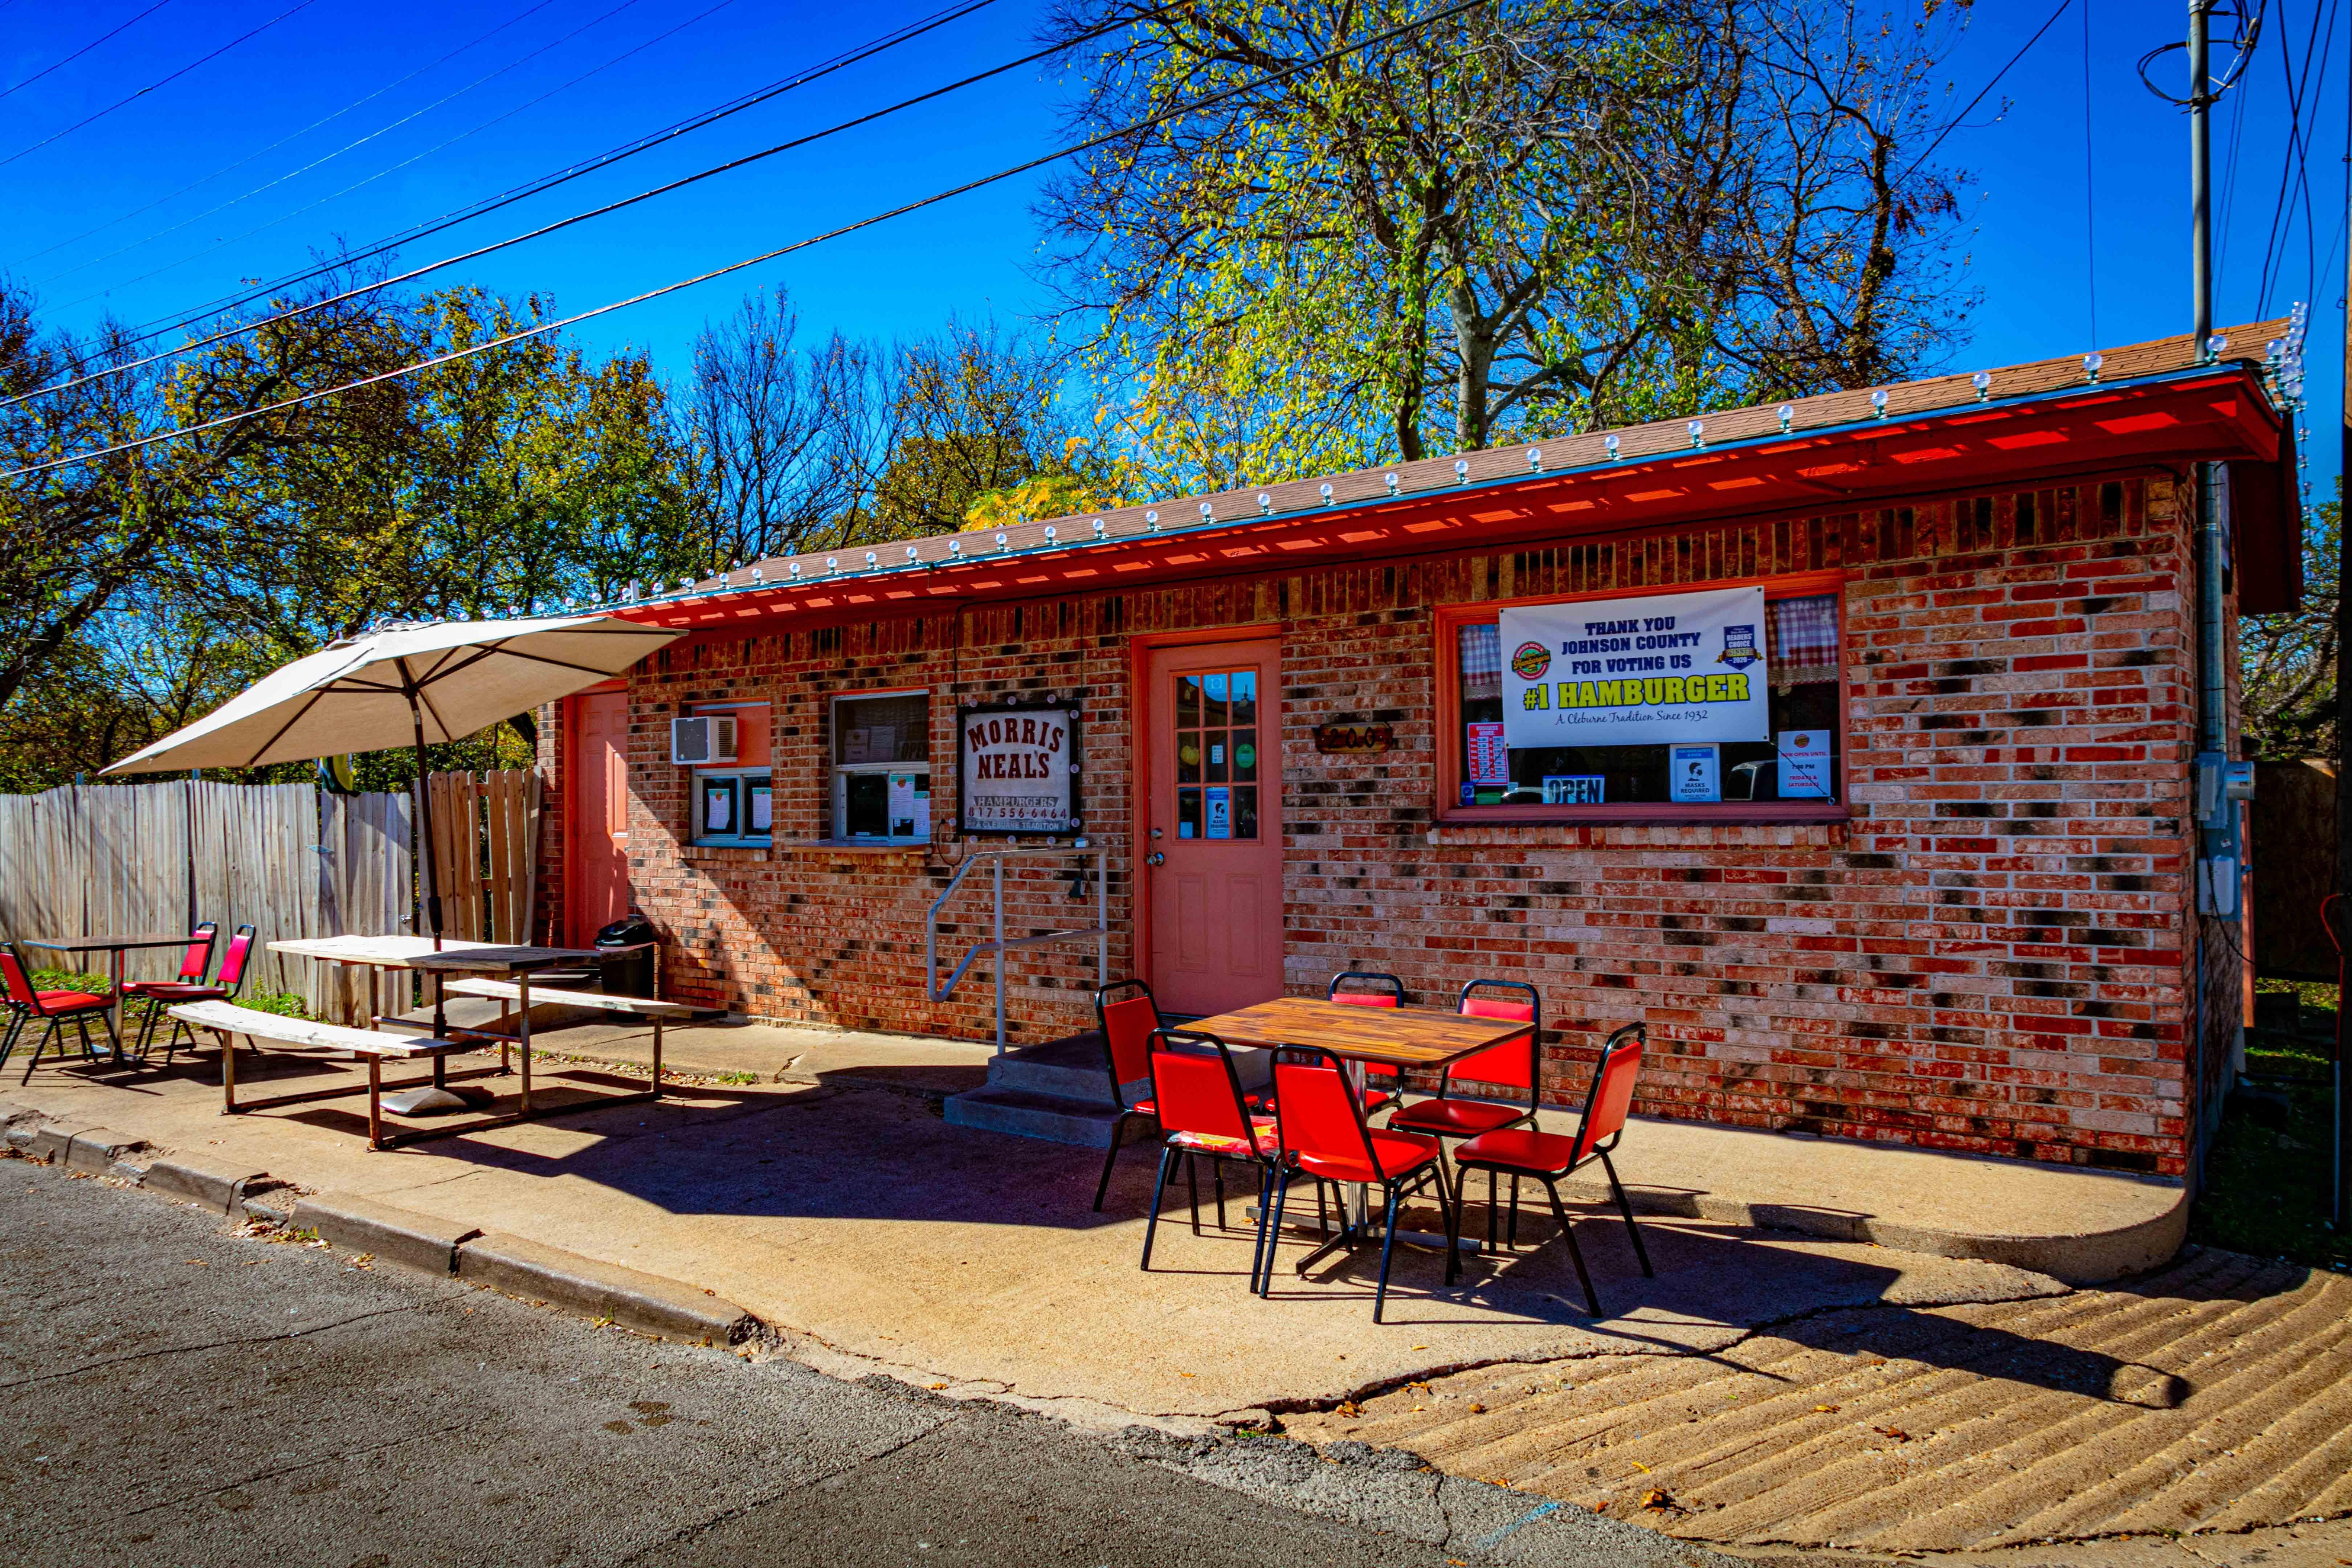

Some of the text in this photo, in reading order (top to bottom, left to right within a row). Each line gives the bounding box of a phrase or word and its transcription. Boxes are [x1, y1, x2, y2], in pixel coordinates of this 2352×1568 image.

[1585, 616, 1675, 636] THANK YOU
[1562, 632, 1701, 655] JOHNSON COUNTY
[1572, 654, 1691, 674] FOR VOTING US
[1523, 673, 1750, 711] #1 HAMBURGER
[1555, 710, 1708, 726] A Cleburne Tradition Since 1932
[967, 718, 1064, 752] MORRIS
[1330, 727, 1376, 748] 200
[977, 750, 1050, 779] NEAL'S
[1548, 779, 1600, 803] OPEN
[968, 807, 1067, 818] 817 556-6464
[978, 797, 1055, 807] HAMBURGERS
